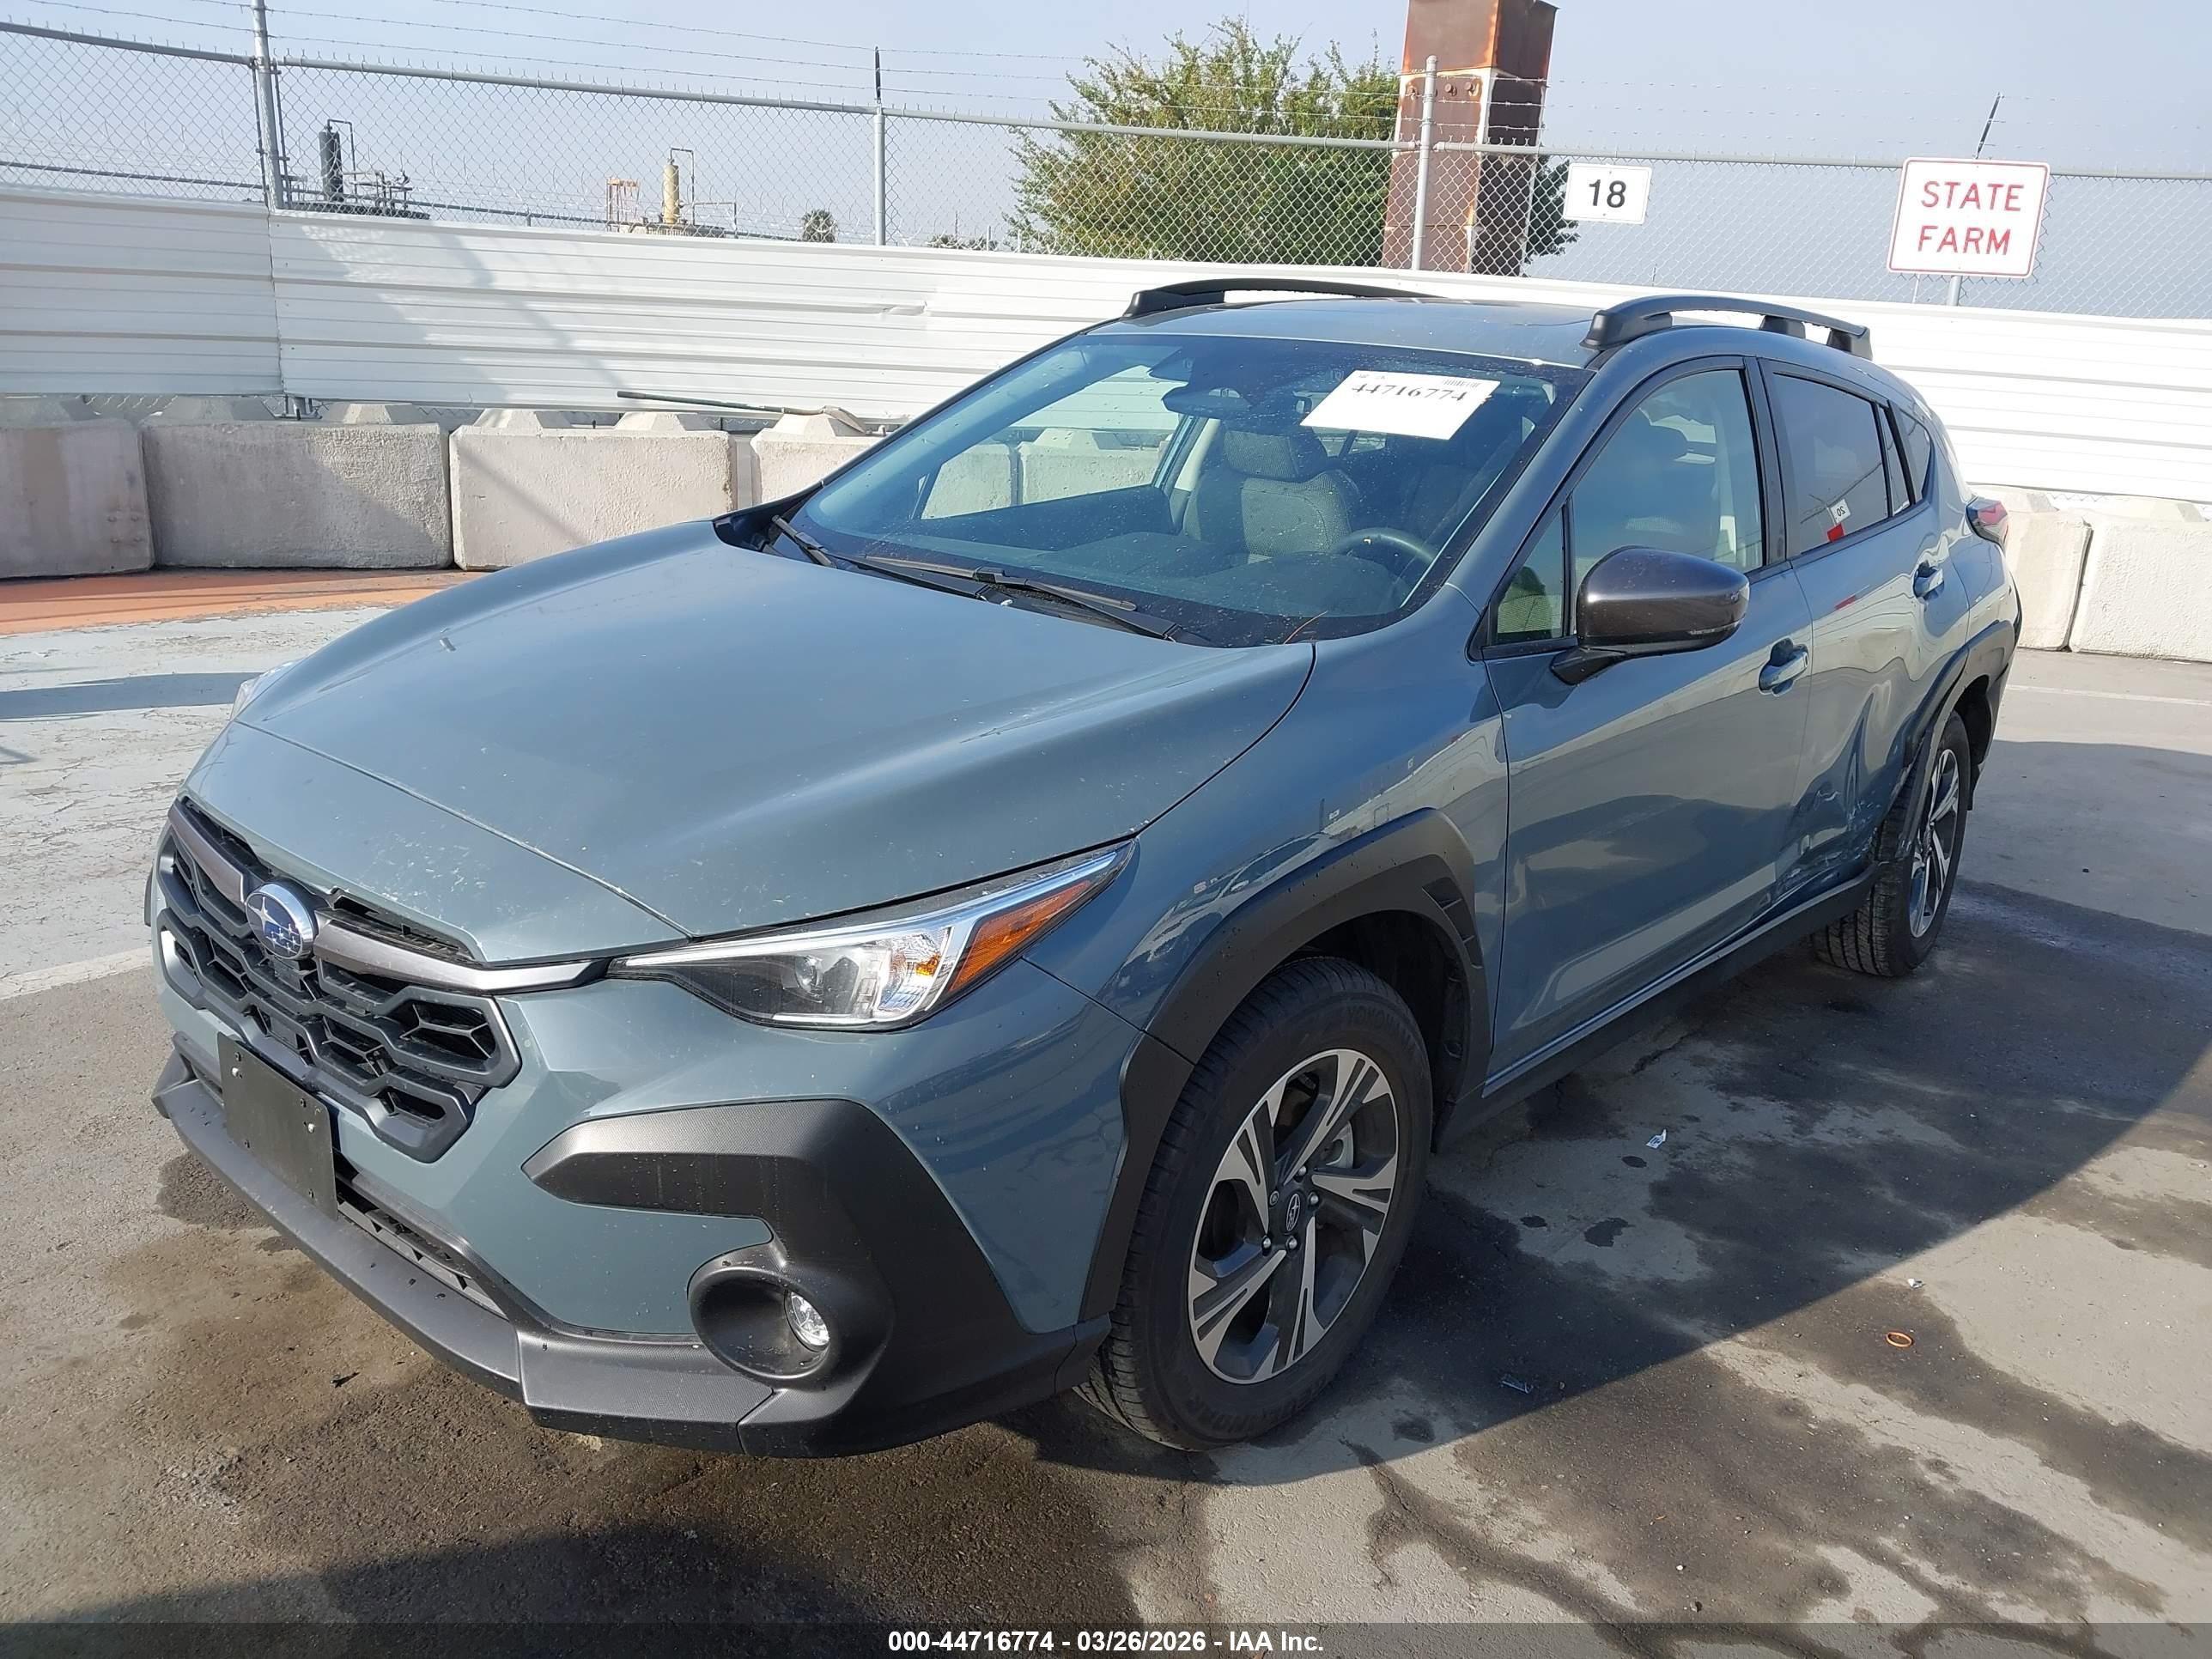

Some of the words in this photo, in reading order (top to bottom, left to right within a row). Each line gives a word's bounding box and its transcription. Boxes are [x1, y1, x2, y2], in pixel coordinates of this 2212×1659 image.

[1588, 179, 1626, 208] 18
[1921, 180, 2024, 211] STATE
[1917, 225, 2011, 255] FARM
[1352, 383, 1468, 401] 44716774
